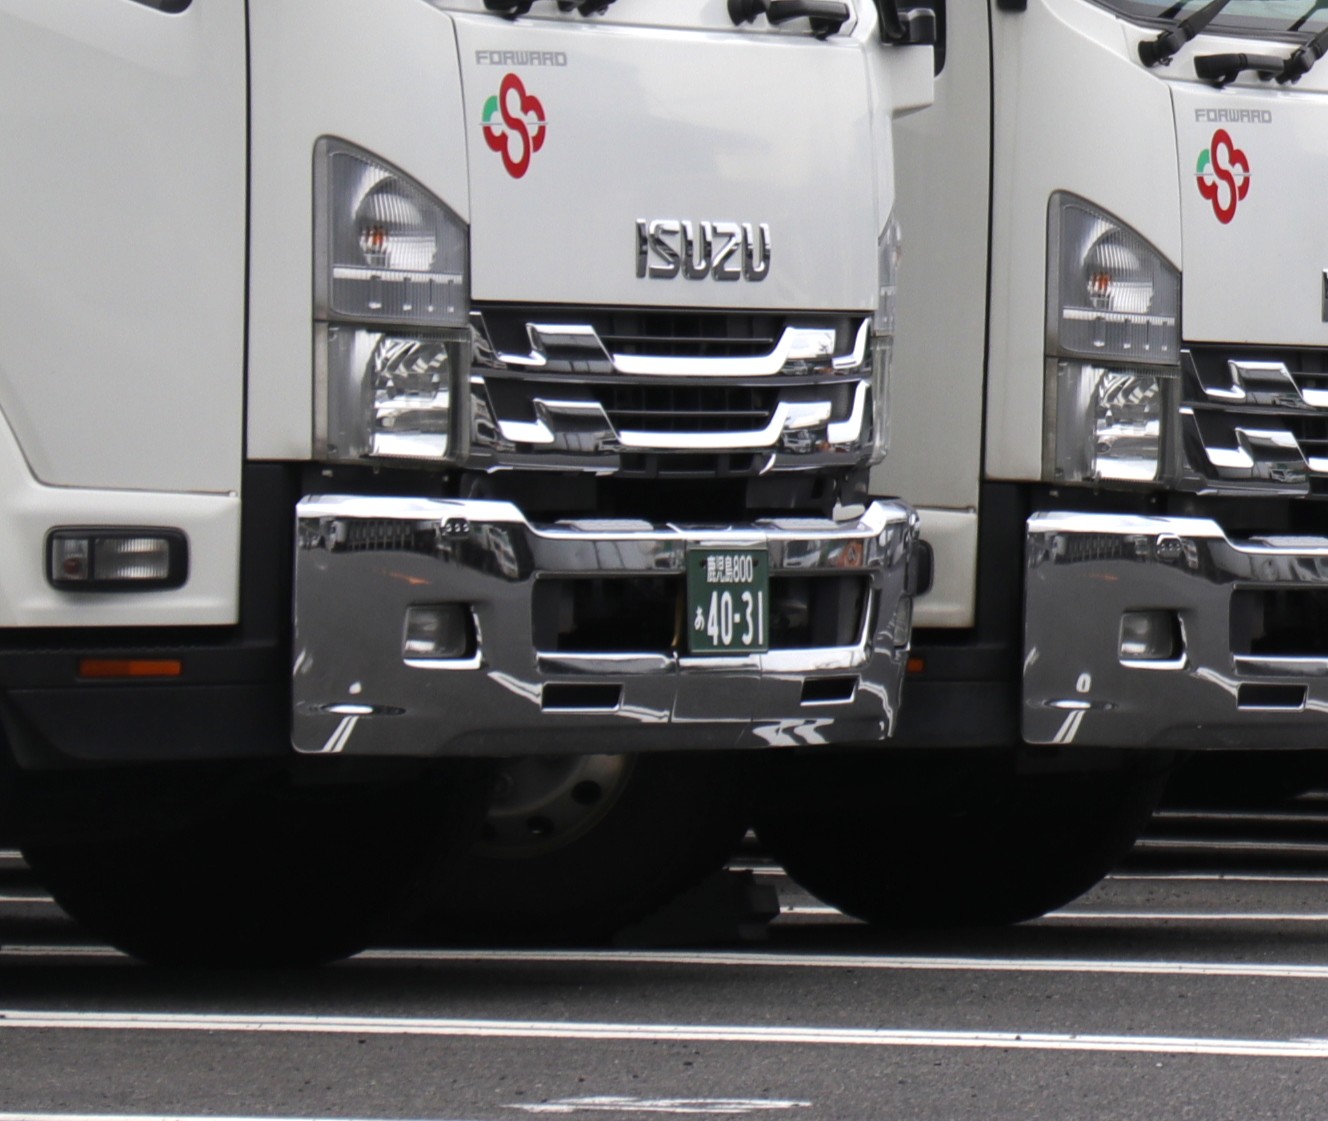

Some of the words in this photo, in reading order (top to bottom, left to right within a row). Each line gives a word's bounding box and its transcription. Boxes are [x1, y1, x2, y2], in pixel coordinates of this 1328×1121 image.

[475, 50, 568, 66] FORWARD
[1194, 108, 1273, 123] FORWARD
[635, 218, 771, 282] ISUZU
[707, 555, 753, 583] 鹿児島800
[707, 591, 764, 646] 40-31
